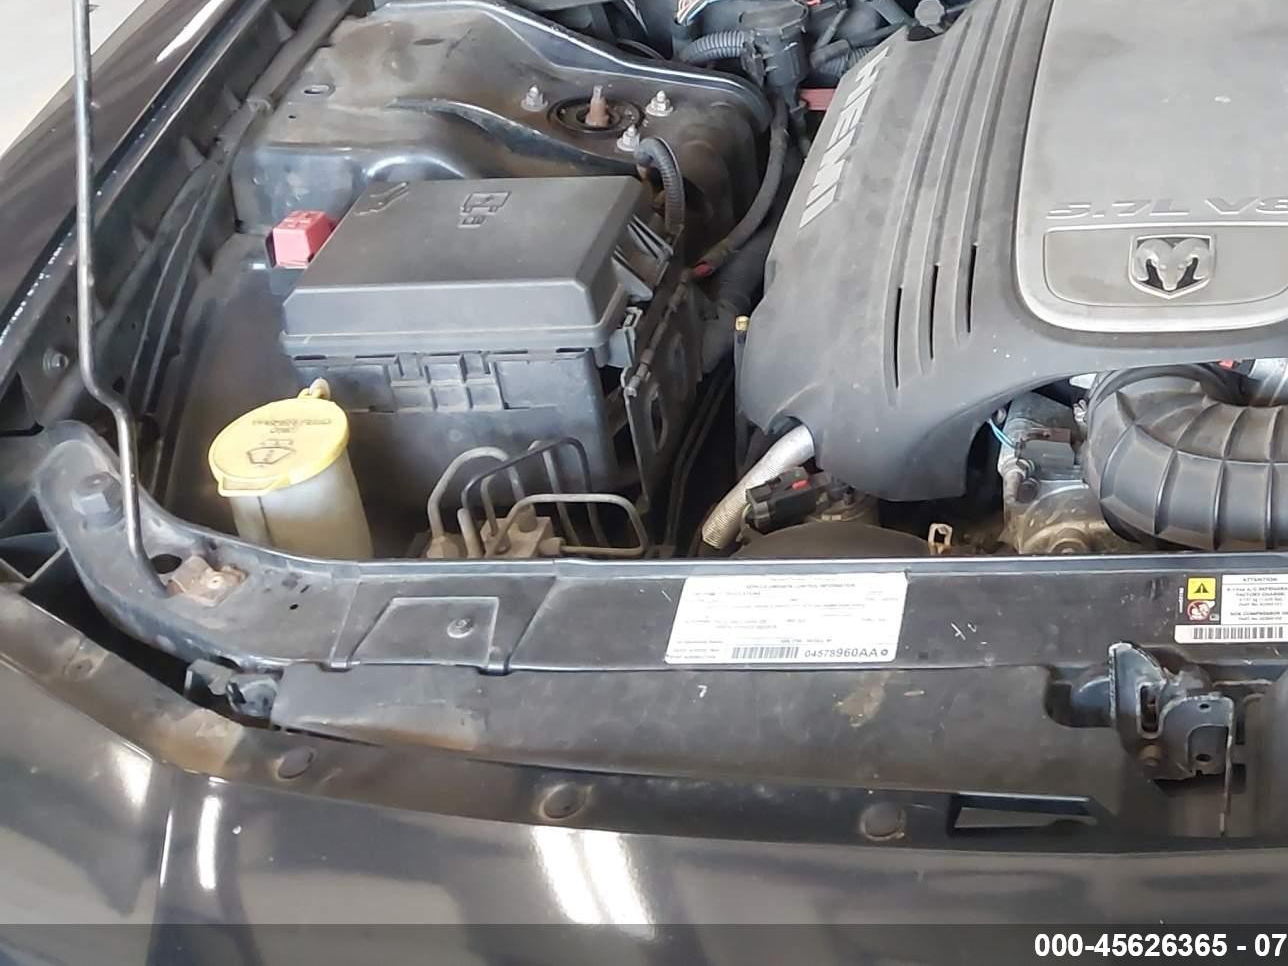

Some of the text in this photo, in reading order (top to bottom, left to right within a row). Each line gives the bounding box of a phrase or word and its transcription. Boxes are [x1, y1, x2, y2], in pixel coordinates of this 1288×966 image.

[800, 45, 890, 228] HEMI
[1046, 199, 1191, 219] 5.7L
[804, 648, 878, 658] 04578960AA
